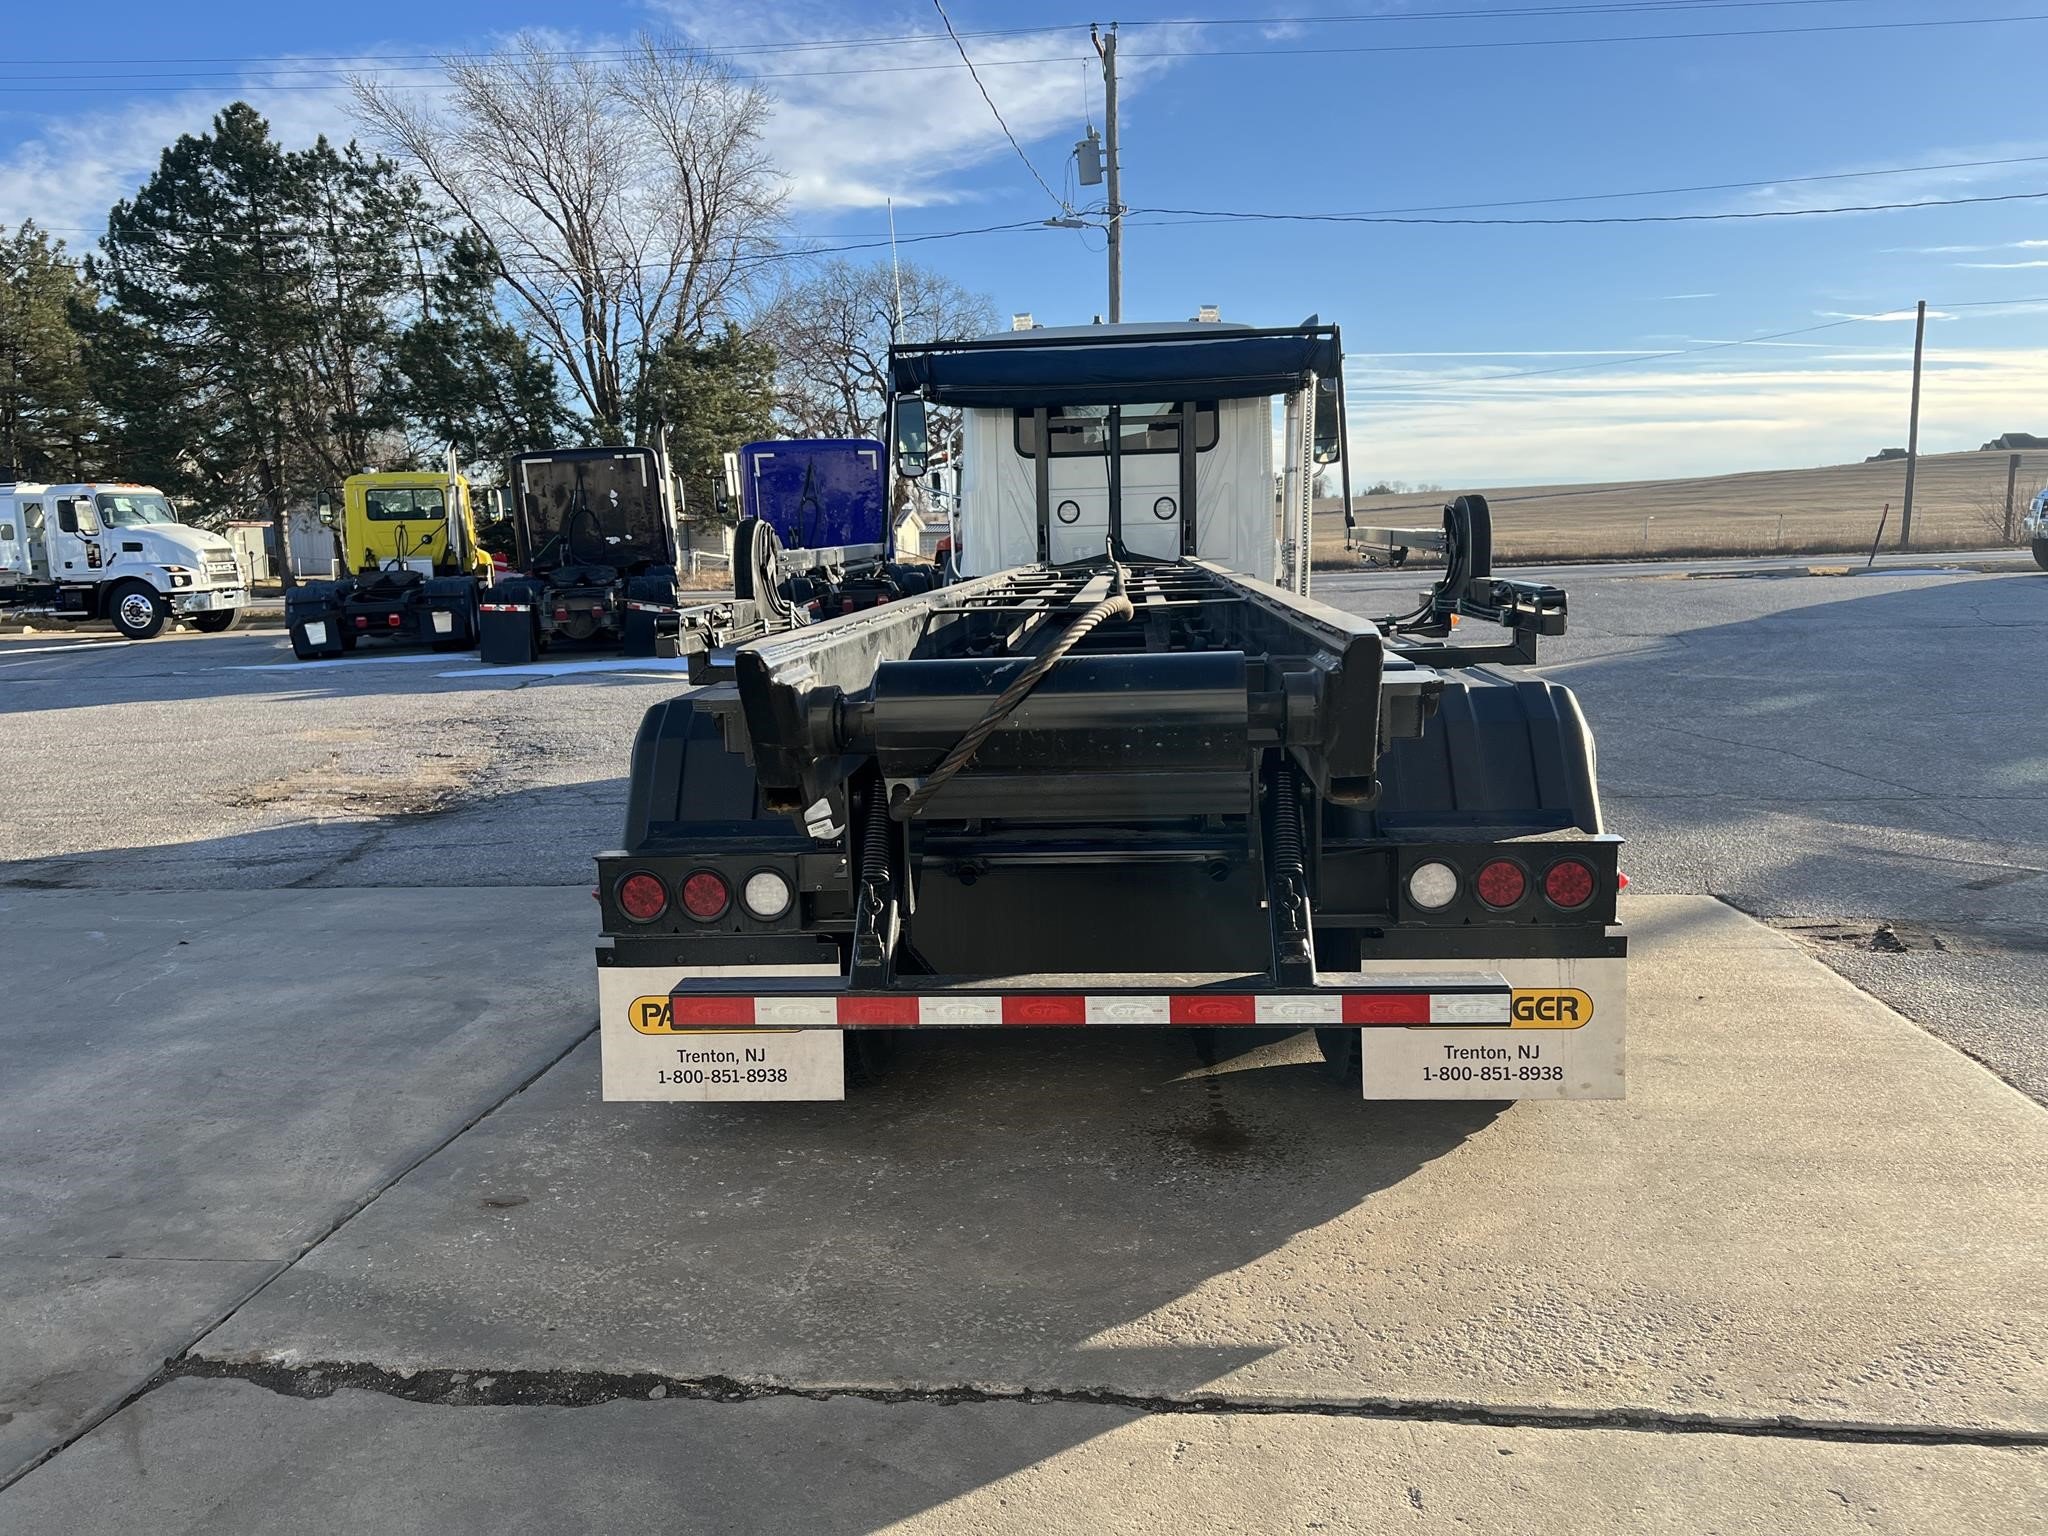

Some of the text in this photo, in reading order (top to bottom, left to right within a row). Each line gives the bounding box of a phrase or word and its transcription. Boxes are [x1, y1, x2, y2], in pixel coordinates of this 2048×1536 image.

[676, 1048, 766, 1065] Trenton, NJ
[1443, 1045, 1540, 1062] Trenton, NJ
[658, 1069, 788, 1084] 1-800-851-8938
[1423, 1066, 1564, 1081] 1-800-851-8938
